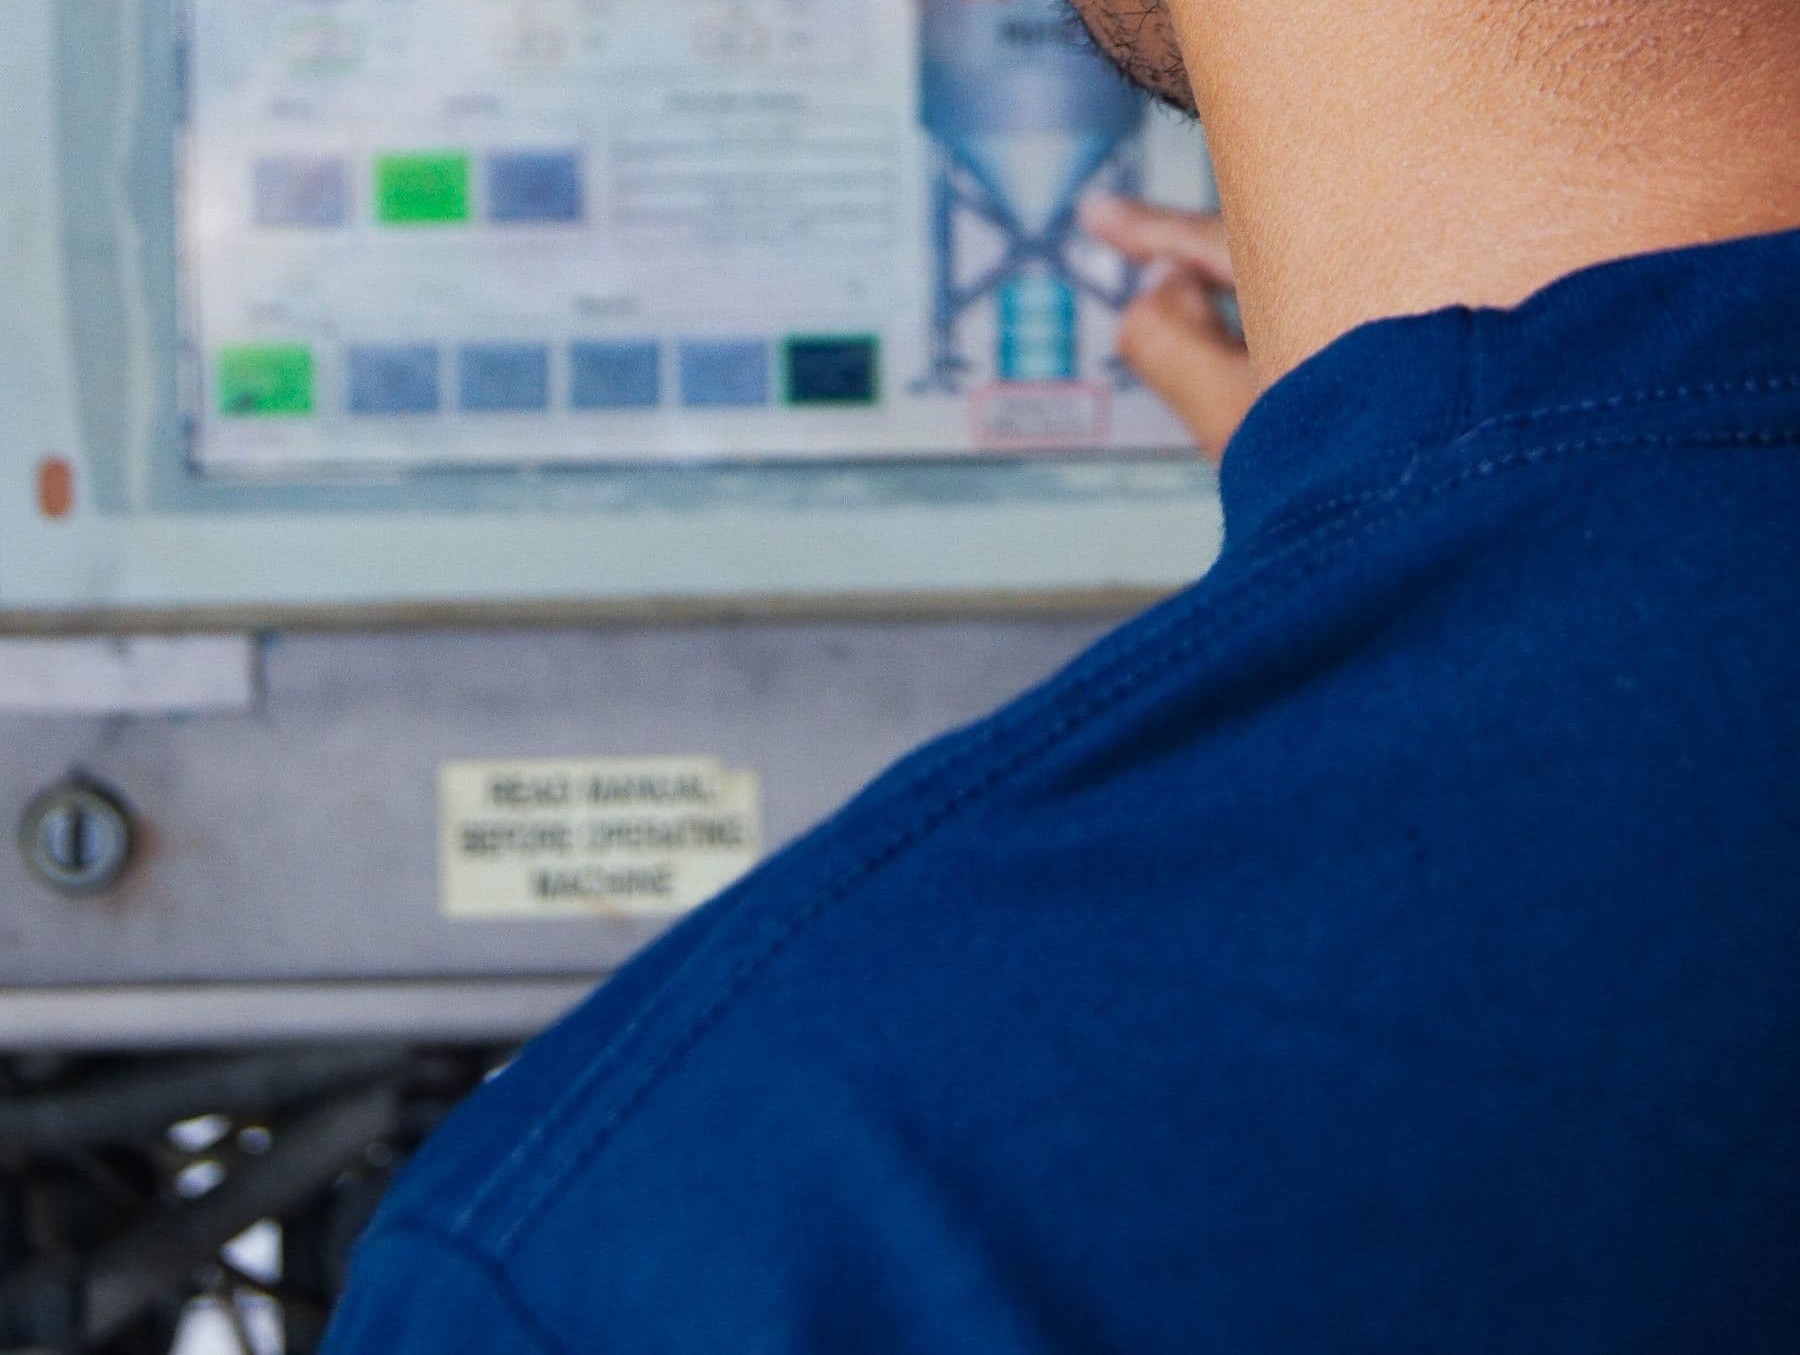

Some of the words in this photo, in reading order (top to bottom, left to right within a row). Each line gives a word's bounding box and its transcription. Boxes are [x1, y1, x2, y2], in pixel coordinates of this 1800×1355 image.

[489, 775, 569, 805] READ
[460, 822, 572, 853] BEFORE
[588, 817, 743, 850] OPERATING
[533, 868, 672, 898] MACHINE
